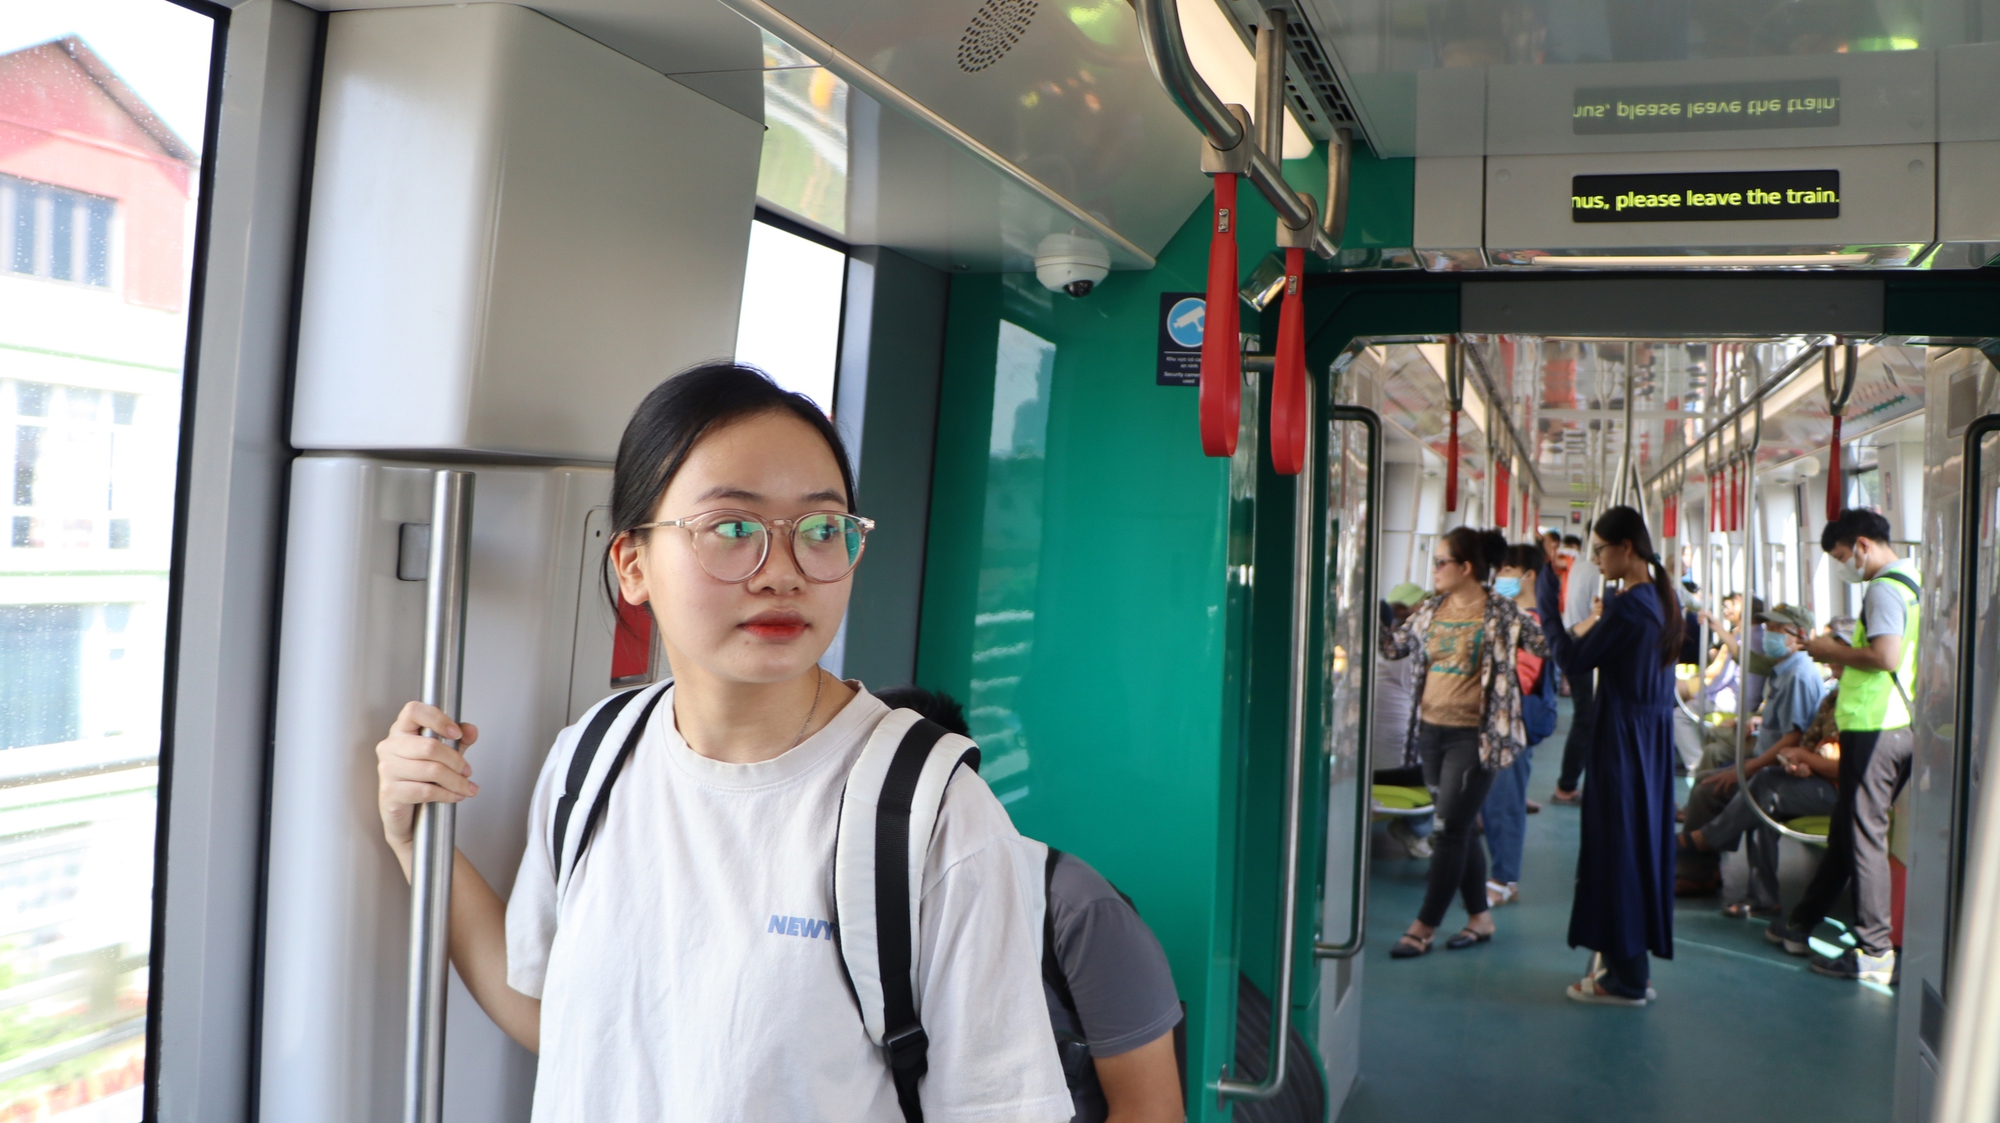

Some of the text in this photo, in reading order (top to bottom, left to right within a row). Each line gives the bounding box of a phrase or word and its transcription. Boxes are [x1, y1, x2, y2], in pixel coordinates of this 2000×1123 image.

[1571, 186, 1840, 211] nus, please leave the train.
